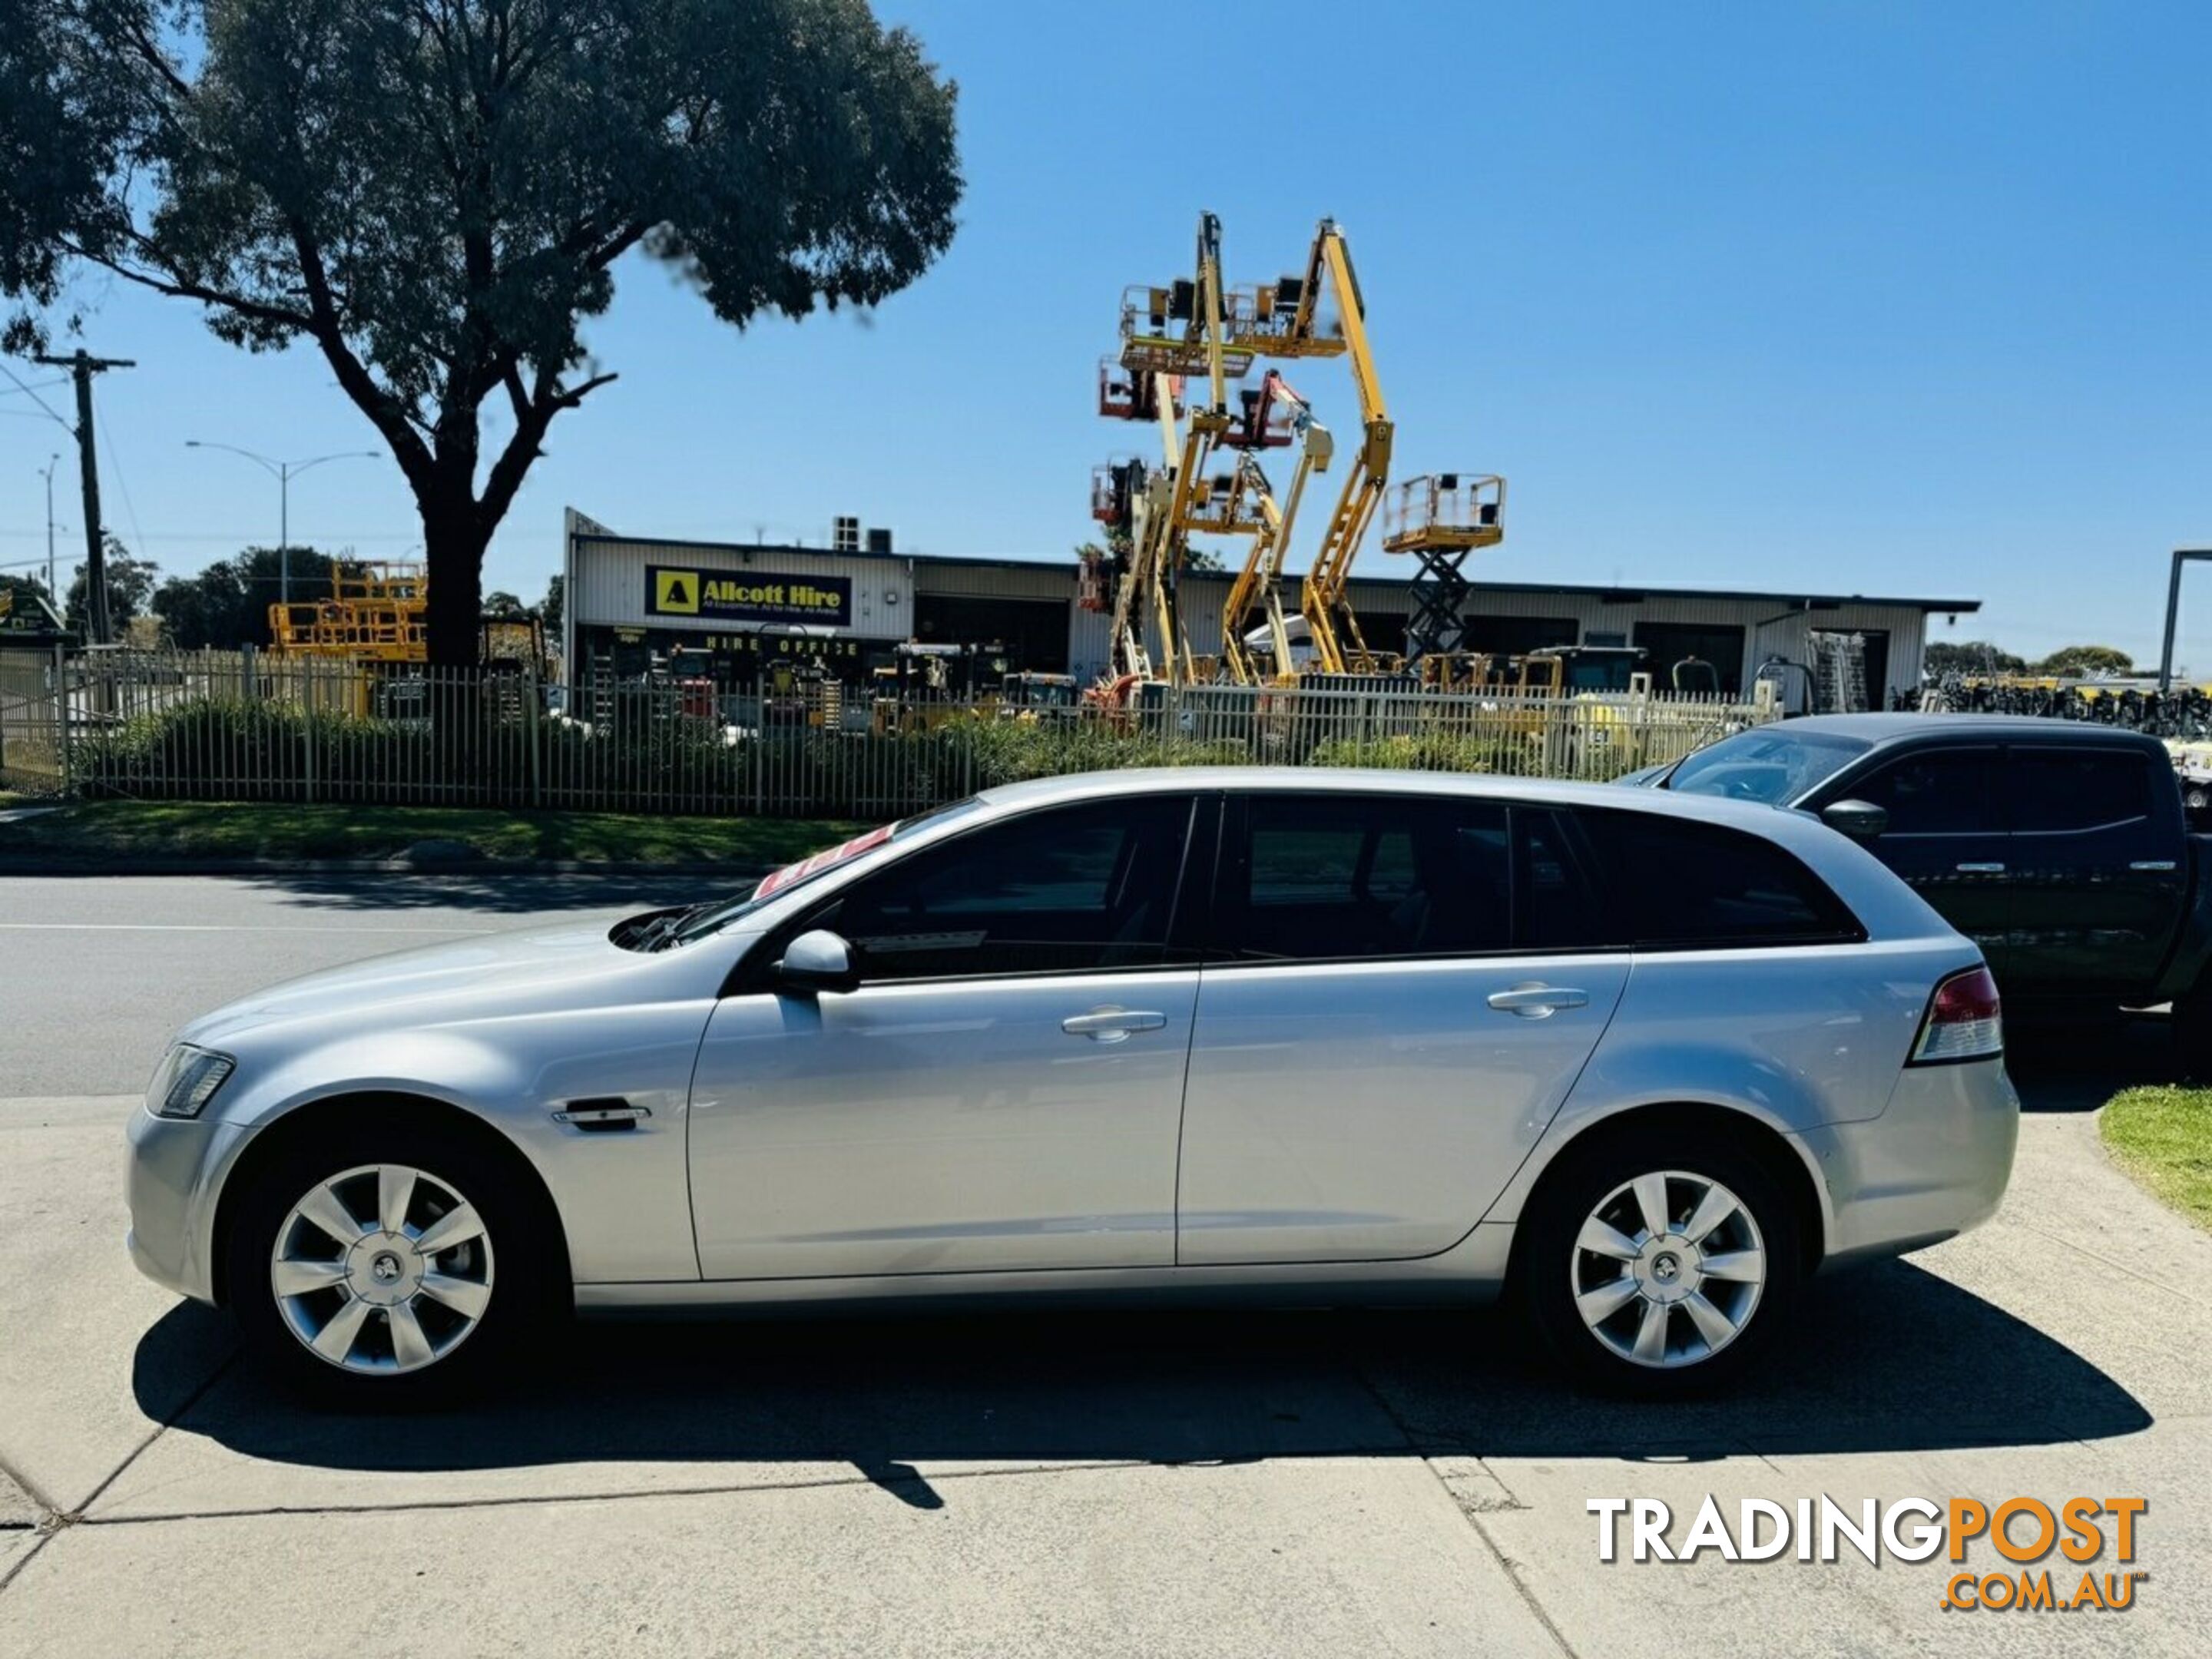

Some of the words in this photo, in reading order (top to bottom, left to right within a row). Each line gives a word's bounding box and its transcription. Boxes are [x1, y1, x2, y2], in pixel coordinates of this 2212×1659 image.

[703, 580, 783, 604] Allcott
[789, 585, 841, 608] Hire
[706, 636, 758, 651] HIRE
